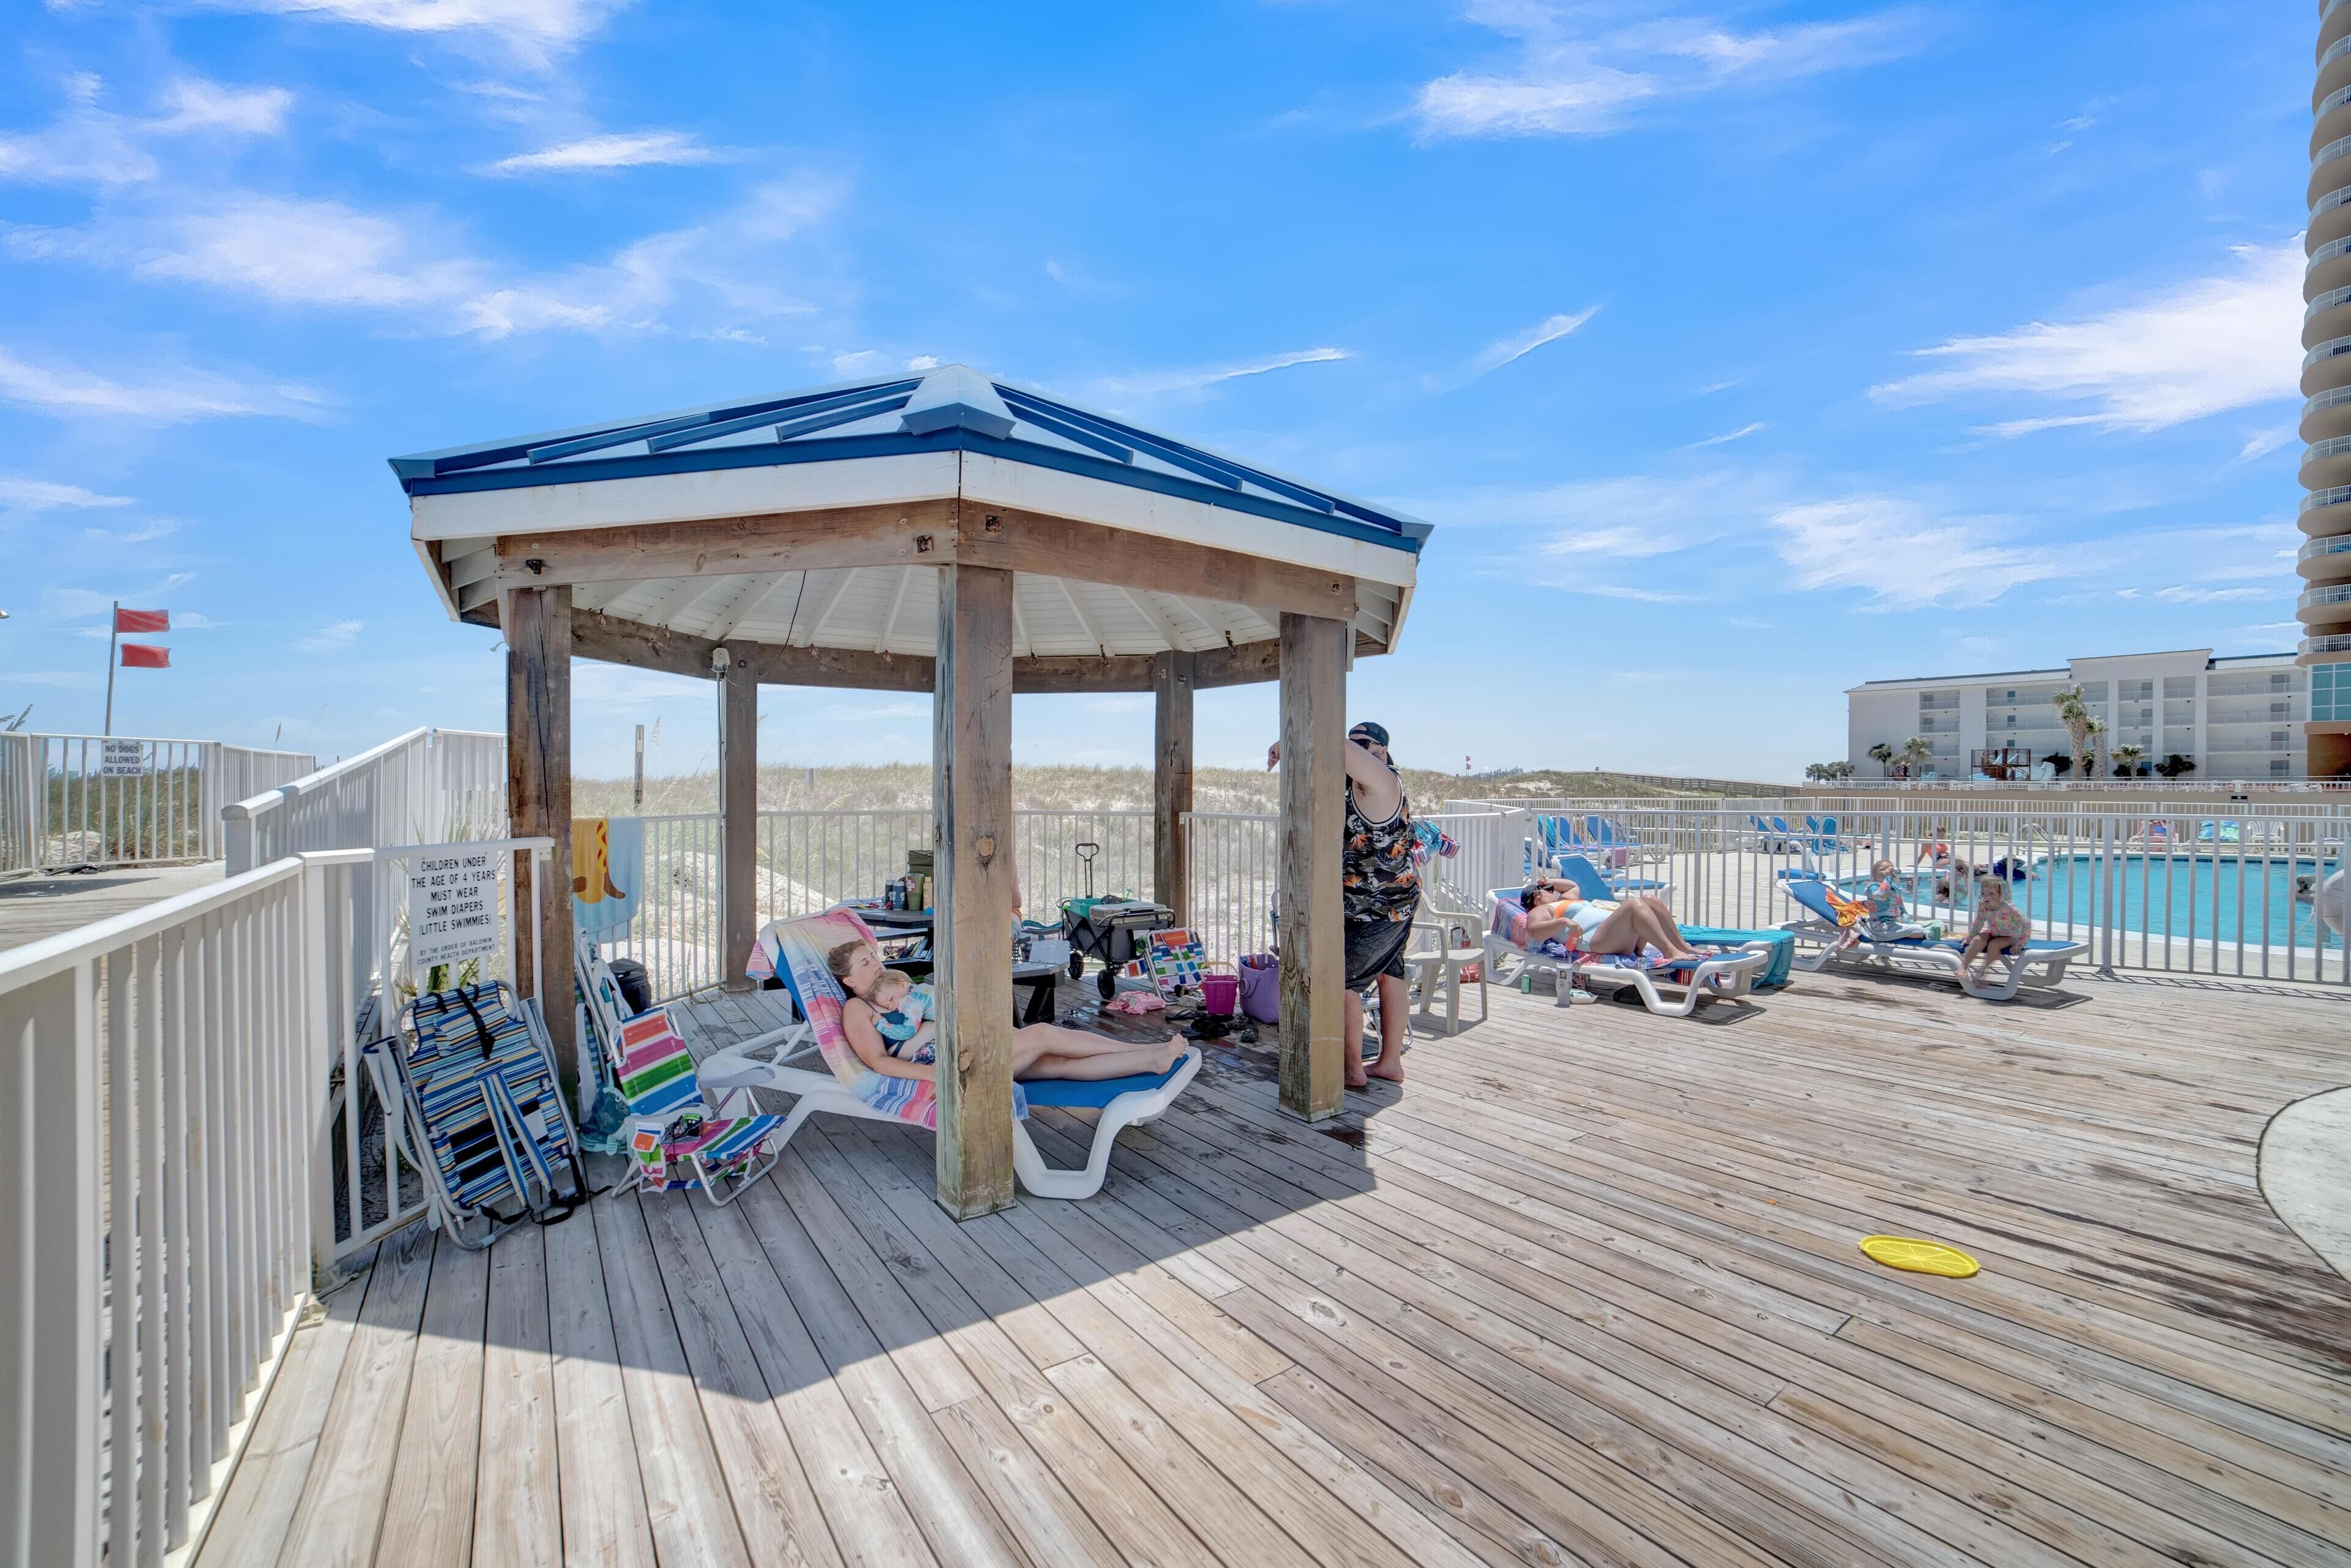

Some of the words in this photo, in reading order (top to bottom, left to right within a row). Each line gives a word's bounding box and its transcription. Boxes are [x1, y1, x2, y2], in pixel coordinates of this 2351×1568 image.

[421, 859, 459, 872] CHILDREN
[462, 856, 486, 868] UNDER
[411, 877, 426, 888] THE
[430, 875, 445, 887] AGE
[449, 874, 459, 885] OF
[463, 872, 467, 882] 4
[471, 869, 495, 882] YEARS
[430, 890, 452, 902] MUST
[456, 887, 479, 898] WEAR
[427, 906, 448, 918] SWIM
[452, 901, 483, 914] DIAPERS
[419, 921, 447, 938] (LITTLE
[451, 914, 491, 930] SWIMMIES)
[469, 937, 492, 946] BALDWIN
[417, 956, 438, 965] COUNTY
[440, 951, 459, 960] HEALTH
[461, 944, 495, 955] DEPARTMENT
